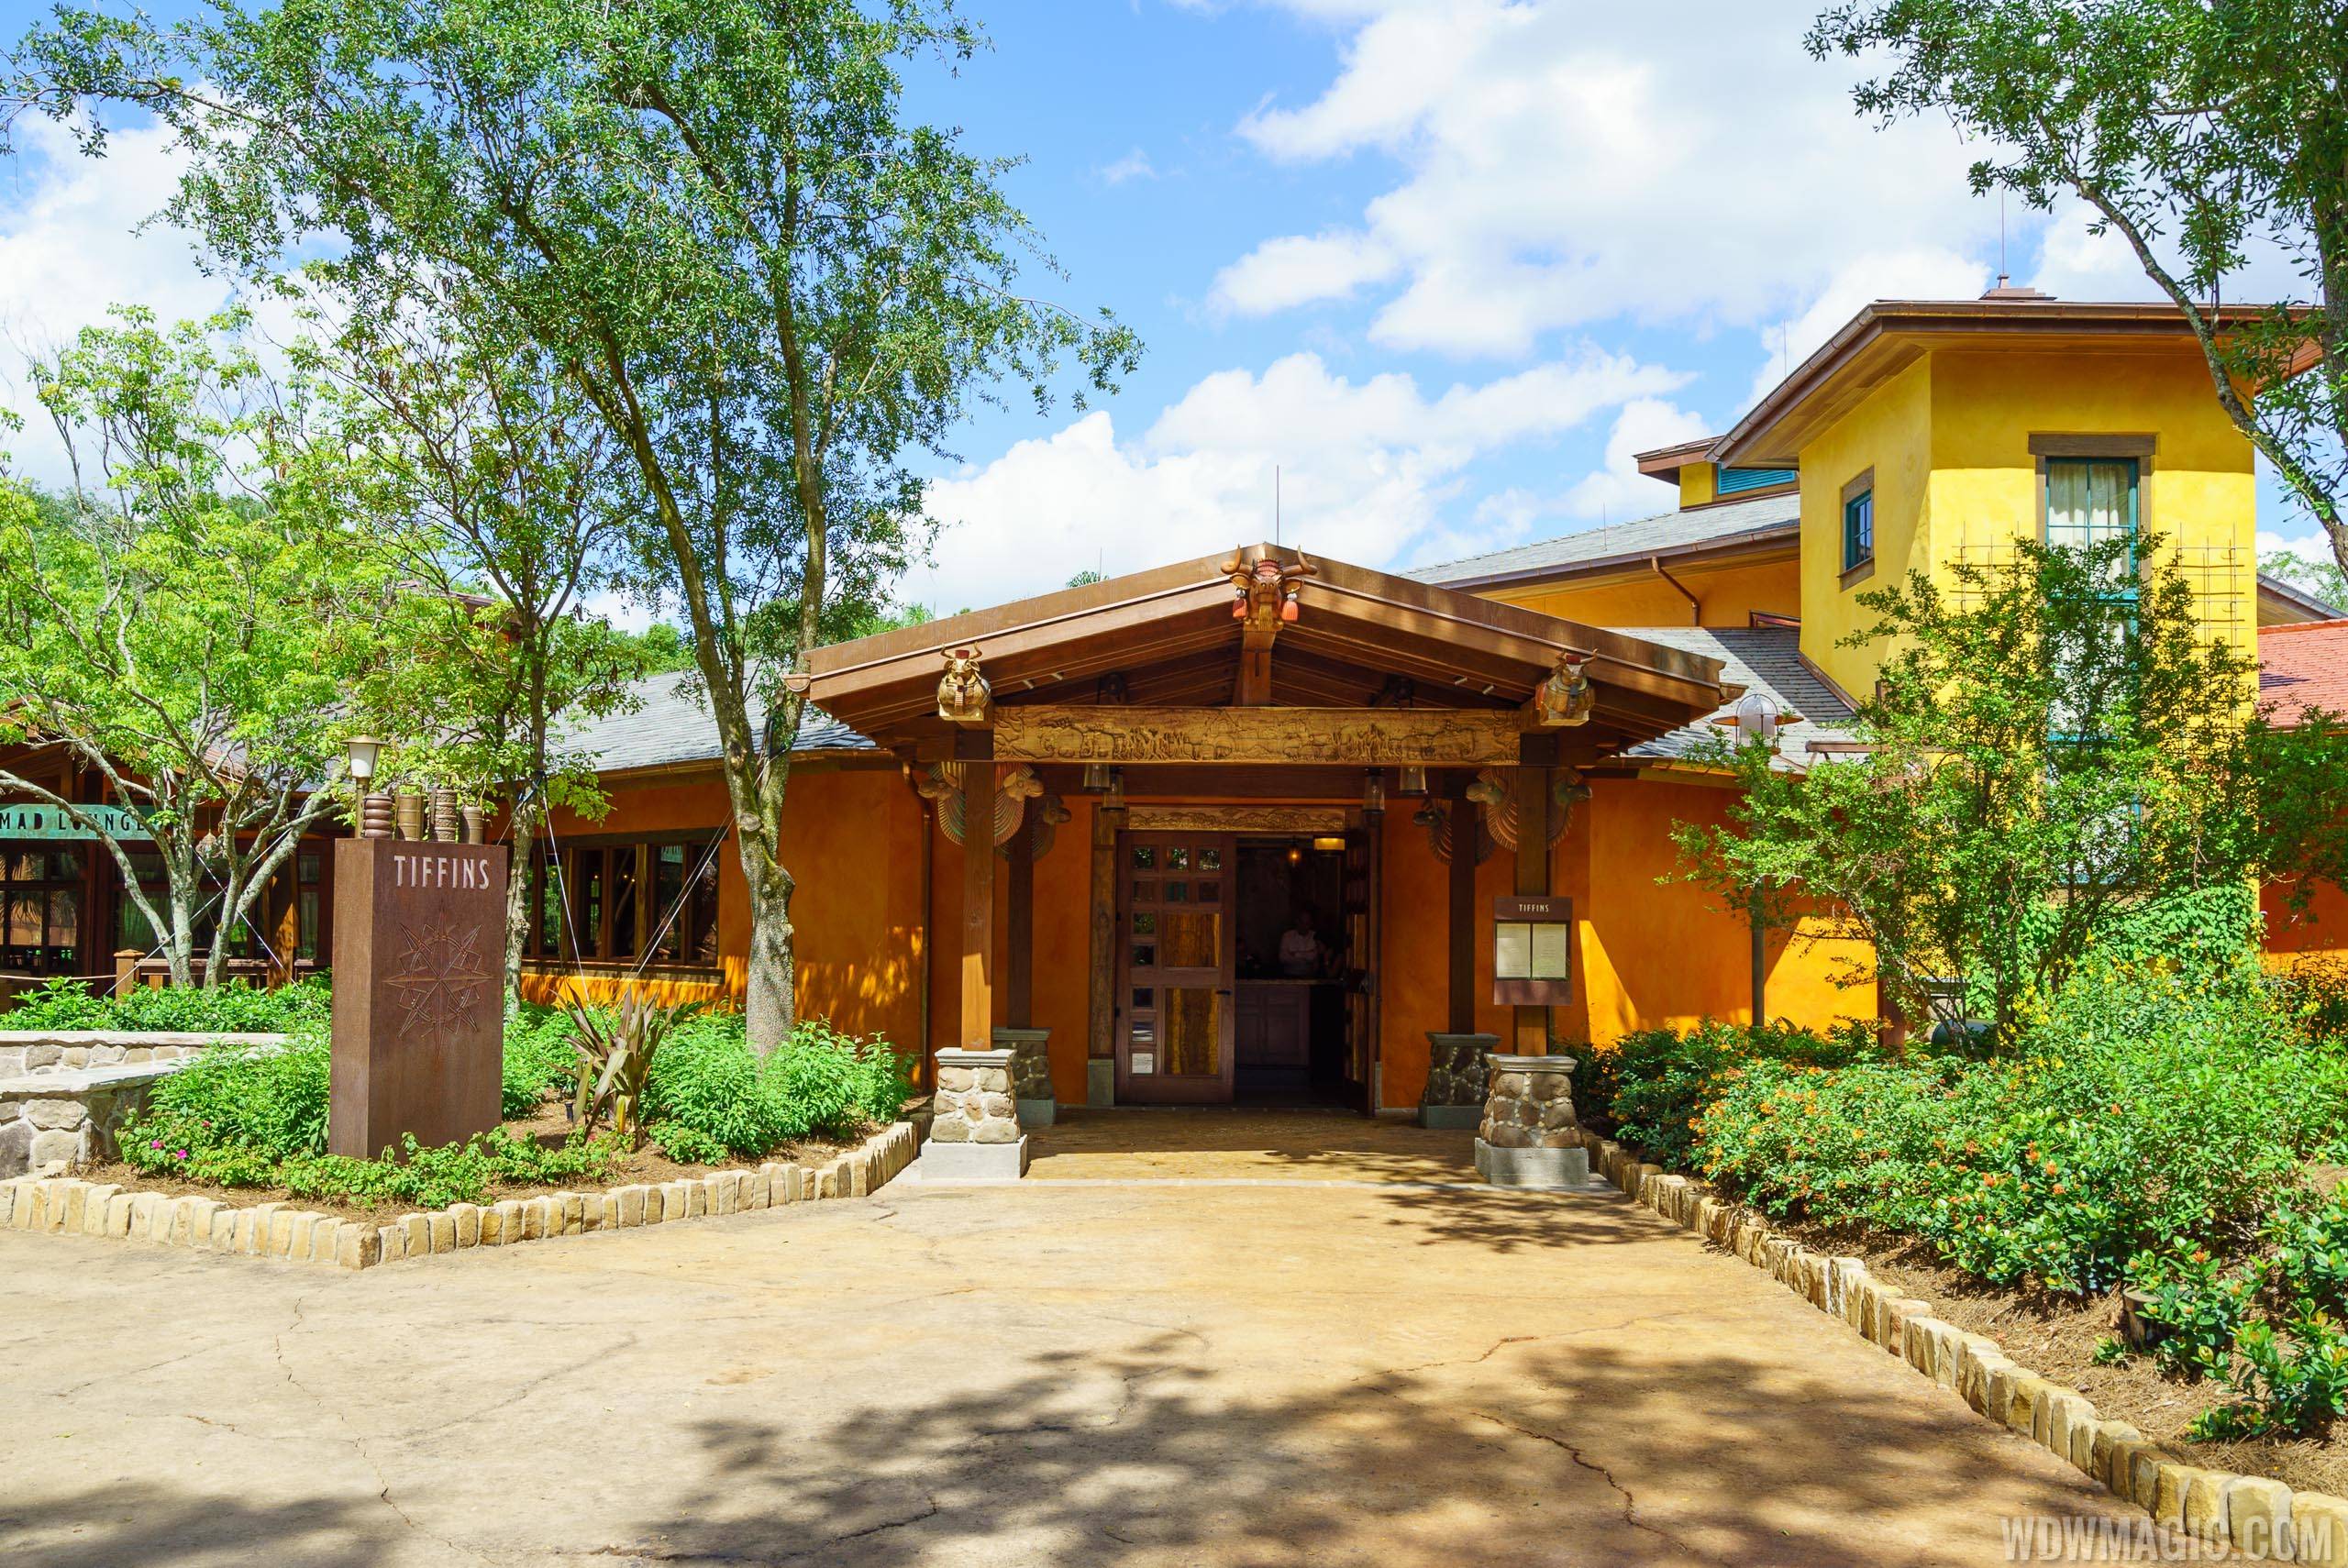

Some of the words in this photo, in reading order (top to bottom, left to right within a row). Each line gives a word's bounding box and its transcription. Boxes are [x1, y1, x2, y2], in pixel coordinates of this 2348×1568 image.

[58, 812, 145, 831] LONG
[393, 855, 490, 889] TIFFINS
[1519, 903, 1549, 912] TIFFINS
